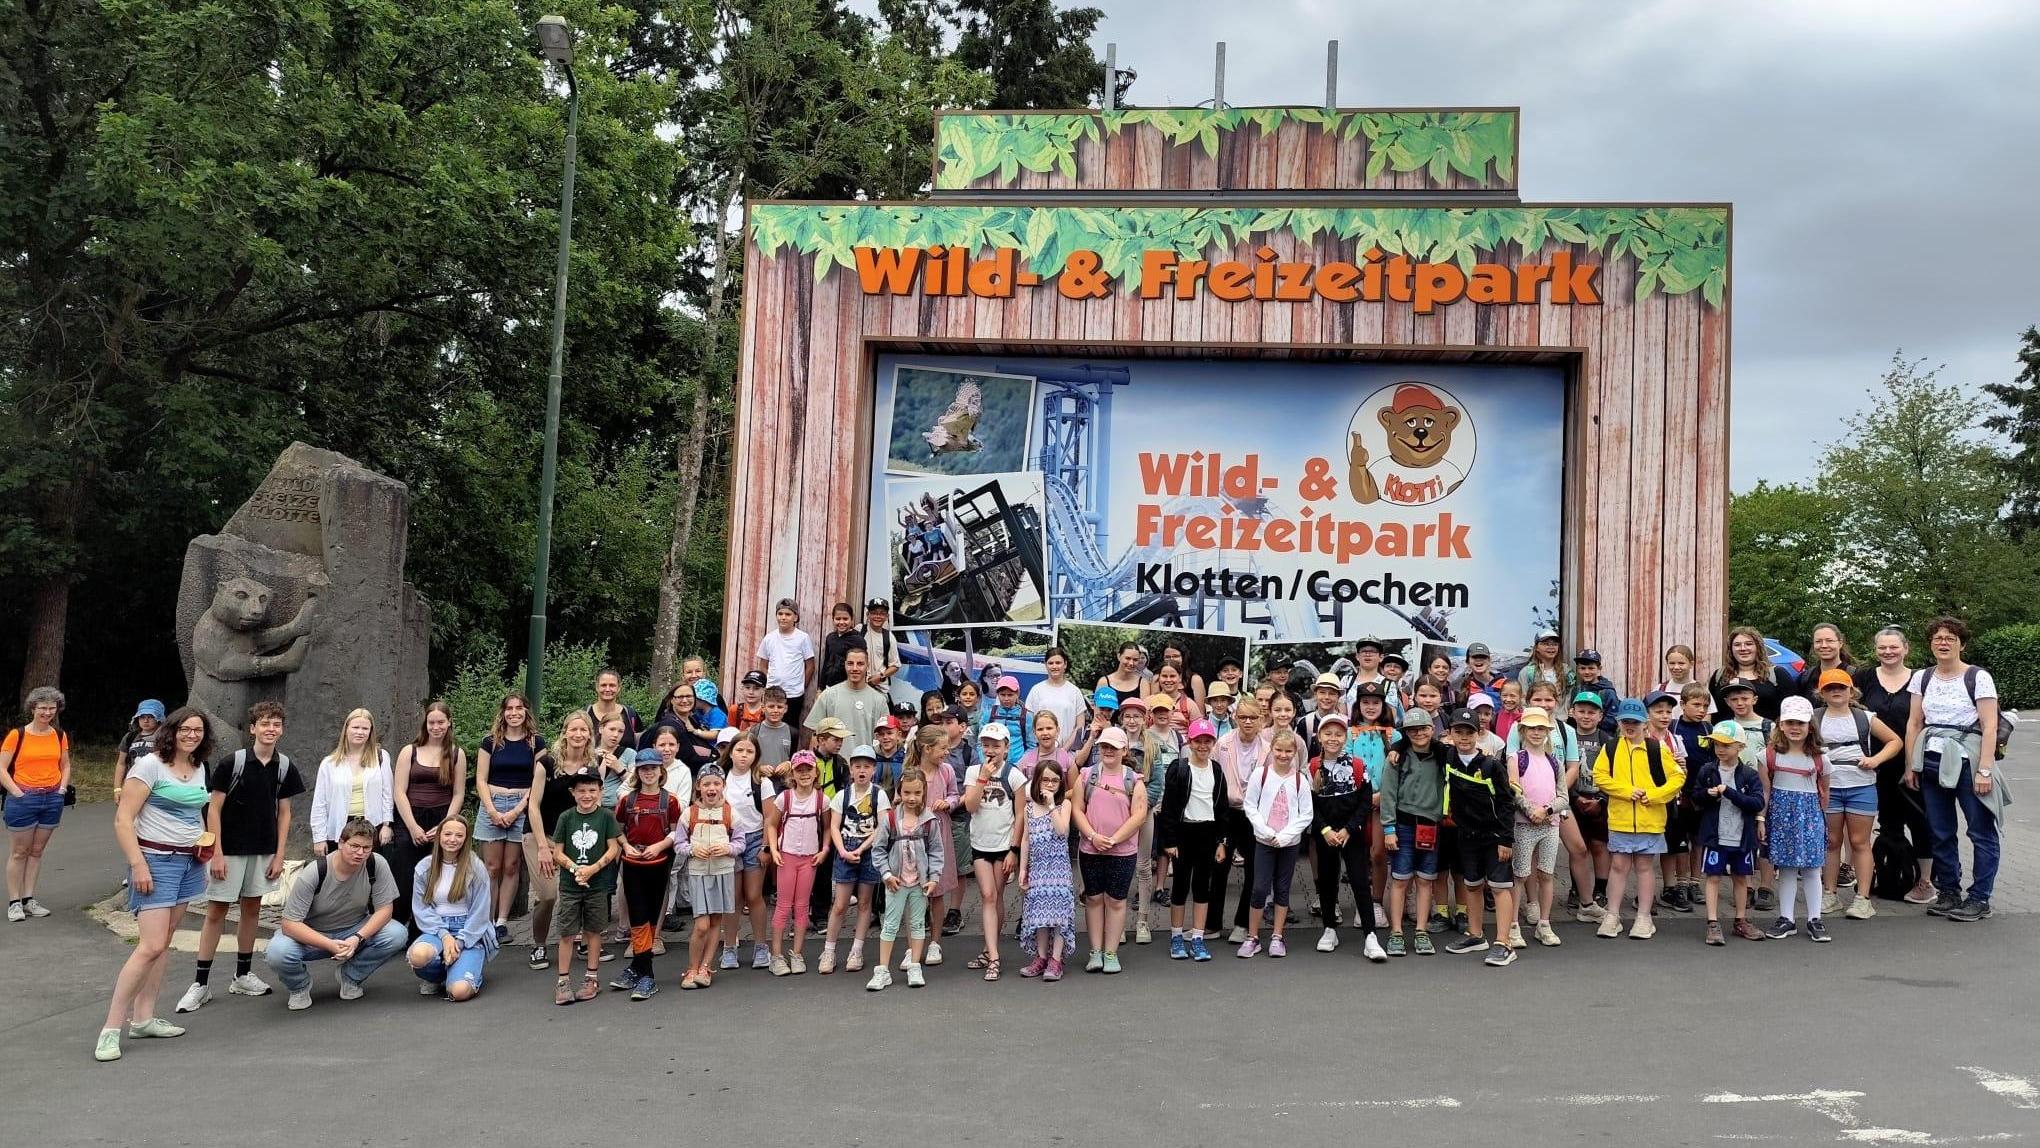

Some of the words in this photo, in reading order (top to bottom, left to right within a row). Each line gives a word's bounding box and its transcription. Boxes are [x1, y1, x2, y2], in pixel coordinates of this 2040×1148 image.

[855, 246, 1041, 298] Wild-
[1059, 250, 1112, 300] &
[1141, 249, 1600, 312] Freizeitpark
[1139, 451, 1278, 498] Wild-
[1299, 457, 1338, 501] &
[1136, 503, 1472, 564] Freizeitpark
[1136, 562, 1469, 608] Klotten/Cochem
